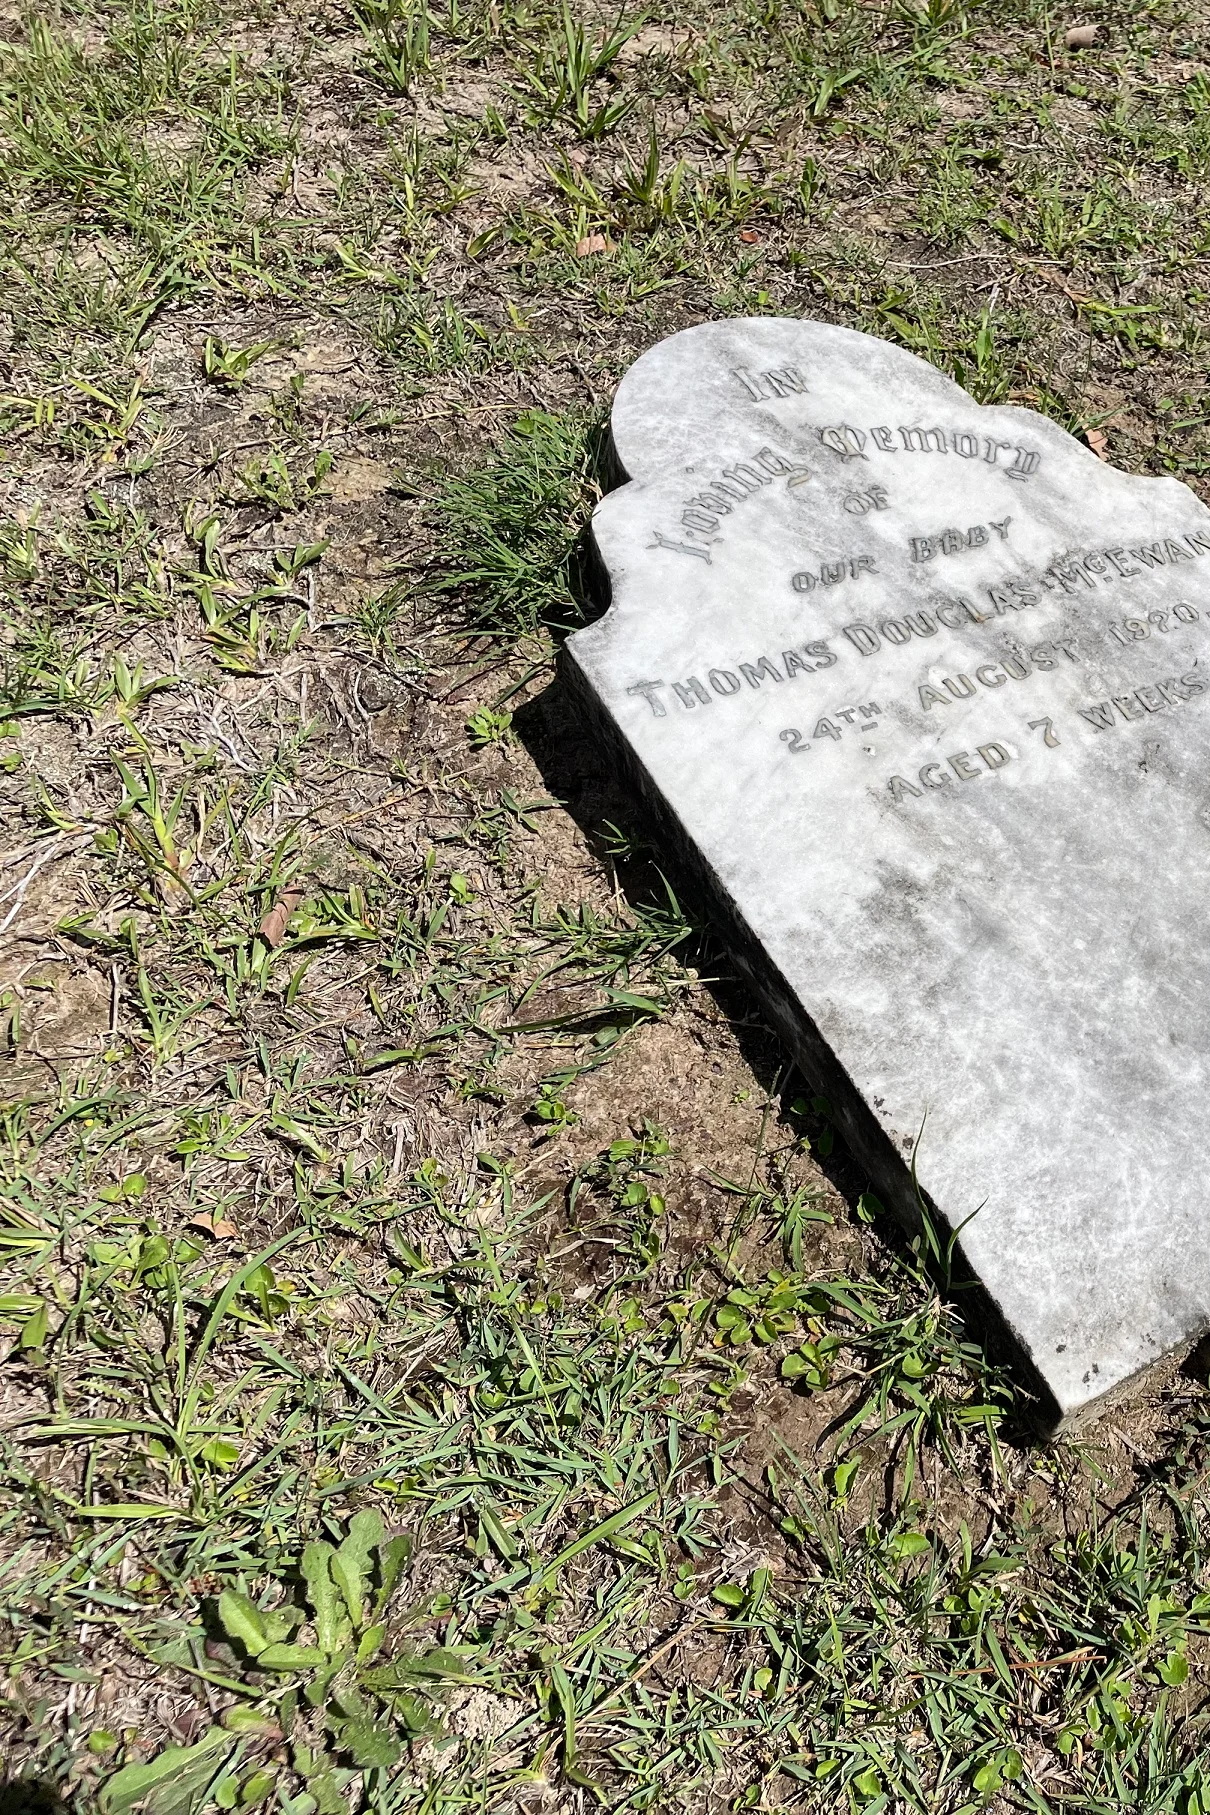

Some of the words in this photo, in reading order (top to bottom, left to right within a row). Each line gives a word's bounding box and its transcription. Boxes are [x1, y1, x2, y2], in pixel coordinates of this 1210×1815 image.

[645, 446, 813, 565] Loving
[820, 424, 1042, 482] Memory
[791, 554, 879, 594] OUR
[908, 516, 1012, 563] BABY
[626, 640, 838, 717] THOMAS
[842, 581, 1043, 656] DOUGLAS
[916, 639, 1080, 711] AUGUST
[887, 742, 1011, 802] AGED
[1027, 716, 1061, 748] 7
